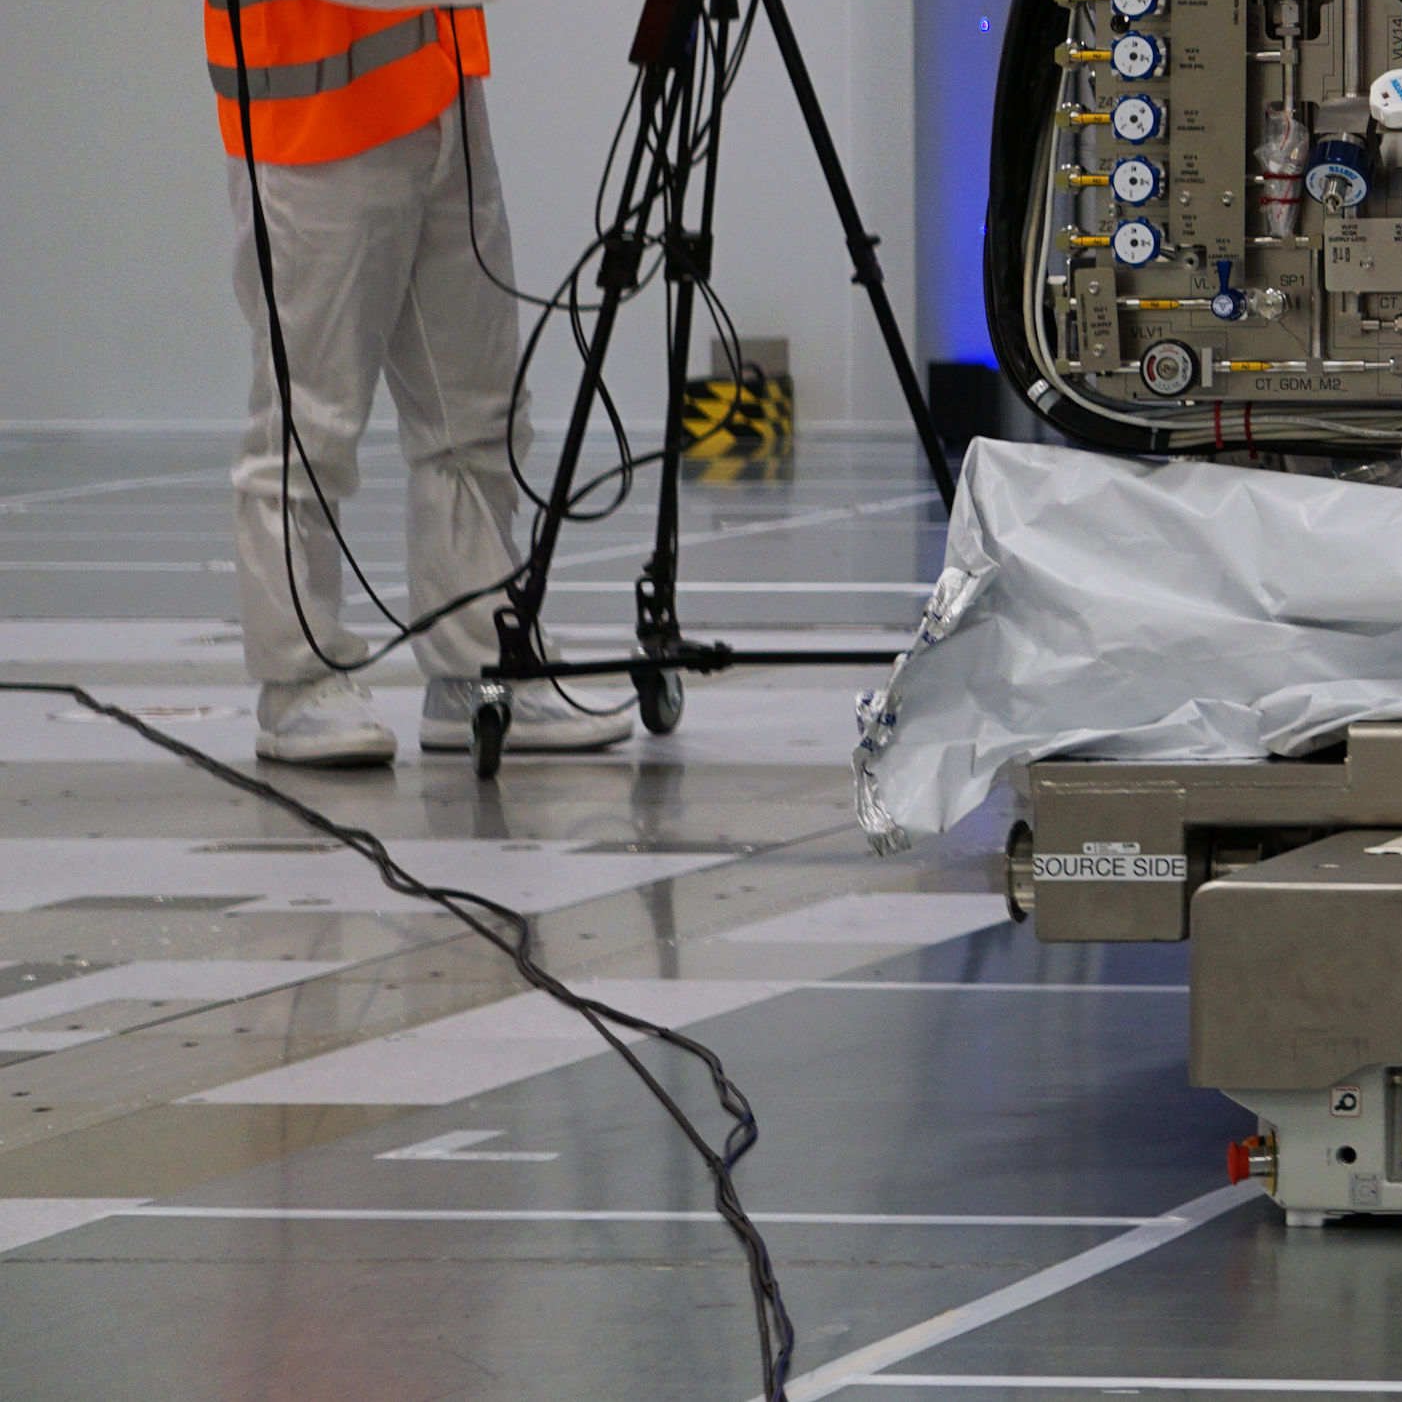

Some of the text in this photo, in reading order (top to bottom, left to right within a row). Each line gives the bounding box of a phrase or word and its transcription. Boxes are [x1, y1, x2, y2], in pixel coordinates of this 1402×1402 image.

[1099, 97, 1113, 108] Z4
[1280, 274, 1305, 287] SP1
[1130, 326, 1163, 338] VLV1
[1033, 857, 1185, 877] SOURCE SIDE
